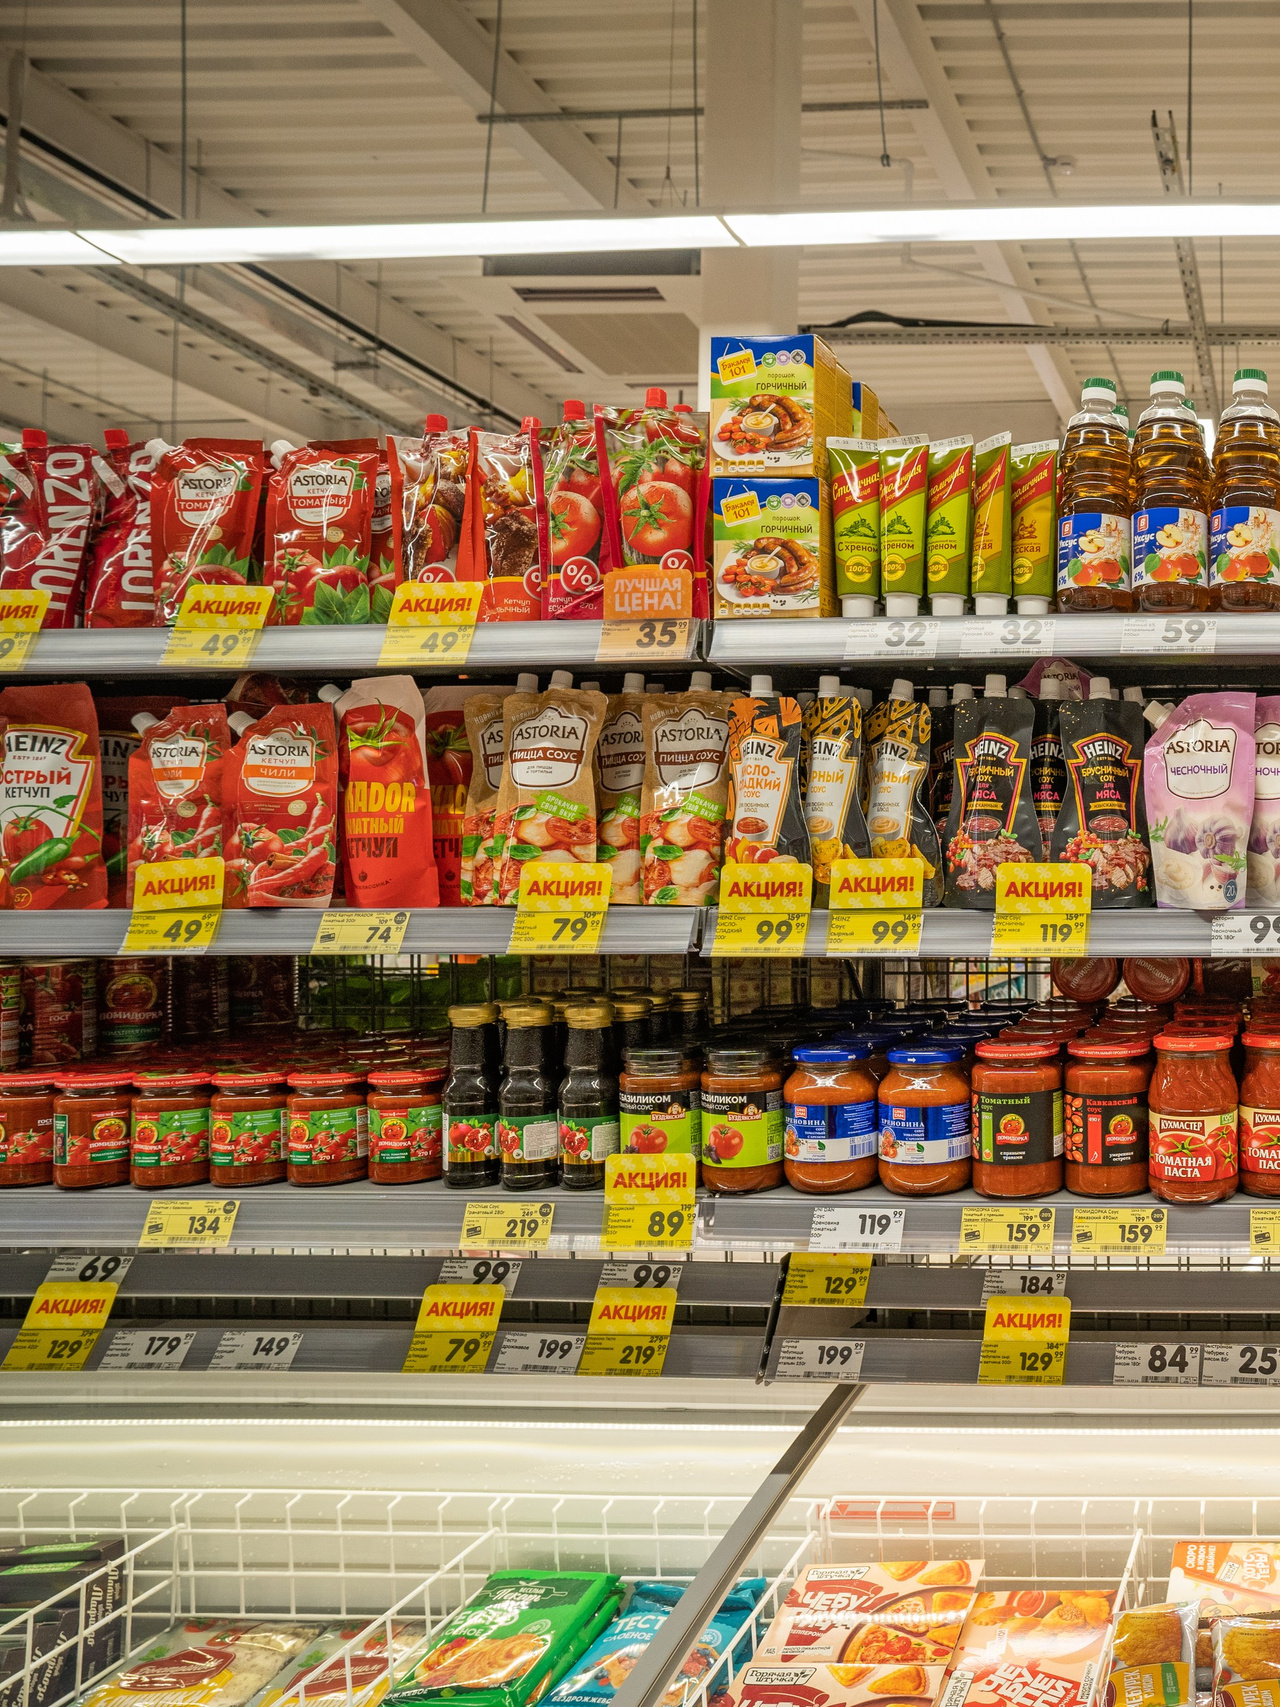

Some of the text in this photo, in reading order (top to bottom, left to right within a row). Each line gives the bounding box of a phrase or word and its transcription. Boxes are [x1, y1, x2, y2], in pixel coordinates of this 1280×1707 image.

[729, 366, 746, 376] 101
[756, 380, 807, 391] ГОРЧИЧНЫЙ
[293, 474, 348, 489] ASTORIA
[761, 524, 812, 534] ГОРЧИЧНЫЙ
[614, 578, 681, 593] ЛУЧШАЯ
[188, 600, 262, 615] АКЦИЯ!
[399, 598, 472, 612] АКЦИЯ!
[614, 593, 682, 611] ЦЕНА!
[636, 622, 676, 647] 35
[885, 622, 926, 647] 32
[1000, 620, 1042, 644] 32
[1161, 620, 1206, 642] 59
[201, 635, 239, 656] 49
[420, 632, 458, 653] 49
[514, 724, 580, 742] ASTORIA
[660, 726, 723, 742] ASTORIA
[249, 744, 309, 757] ASTORIA
[512, 750, 578, 762] ПИЦЦА СОУС
[975, 741, 1009, 758] HEINZ
[1084, 741, 1123, 759] HEINZ
[1166, 740, 1230, 755] ASTORIA
[660, 751, 720, 763] ПИЦЦА СОУС
[260, 767, 296, 777] ЧИЛИ
[1082, 765, 1129, 778] БРУСНИЧНЫЙ
[1100, 774, 1116, 783] СОУС
[1170, 765, 1228, 776] ЧЕСНОЧНЫЙ
[5, 787, 50, 798] КЕТЧУП
[743, 790, 760, 799] СОУС
[1096, 790, 1121, 800] МЯСА
[143, 875, 216, 896] АКЦИЯ!
[527, 881, 602, 897] АКЦИЯ!
[728, 880, 803, 898] АКЦИЯ!
[838, 876, 914, 894] АКЦИЯ!
[1005, 881, 1083, 900] АКЦИЯ!
[164, 920, 201, 943] 49
[366, 927, 392, 943] 74
[552, 918, 588, 941] 79
[756, 920, 792, 944] 99
[872, 920, 908, 944] 99
[1040, 924, 1072, 943] 119
[980, 1096, 1030, 1104] Томатный
[1086, 1098, 1137, 1107] Кавказский
[1160, 1118, 1203, 1132] КУХМАСТЕР
[996, 1134, 1028, 1142] ПОМИДОРКА
[1155, 1154, 1212, 1168] ТОМАТНАЯ
[613, 1171, 687, 1190] АКЦИЯ!
[1165, 1166, 1201, 1178] ПАСТА
[188, 1216, 219, 1235] 134
[505, 1219, 539, 1238] 219
[648, 1211, 683, 1237] 89
[859, 1214, 891, 1235] 119
[1006, 1223, 1041, 1242] 159
[1119, 1224, 1152, 1243] 159
[78, 1256, 120, 1282] 69
[472, 1261, 510, 1285] 99
[633, 1265, 671, 1288] 99
[825, 1276, 856, 1294] 129
[1020, 1276, 1054, 1294] 184
[36, 1299, 106, 1314] АКЦИЯ!
[427, 1302, 494, 1318] АКЦИЯ!
[599, 1305, 668, 1322] АКЦИЯ!
[992, 1313, 1062, 1328] АКЦИЯ!
[47, 1339, 82, 1359] 129
[148, 1337, 181, 1356] 179
[252, 1337, 289, 1357] 149
[448, 1339, 480, 1362] 79
[538, 1340, 572, 1359] 199
[619, 1345, 655, 1365] 219
[818, 1346, 851, 1365] 199
[1019, 1352, 1053, 1371] 129
[1148, 1345, 1188, 1373] 84
[1239, 1346, 1278, 1375] 25
[1186, 1544, 1197, 1568] СКОРО
